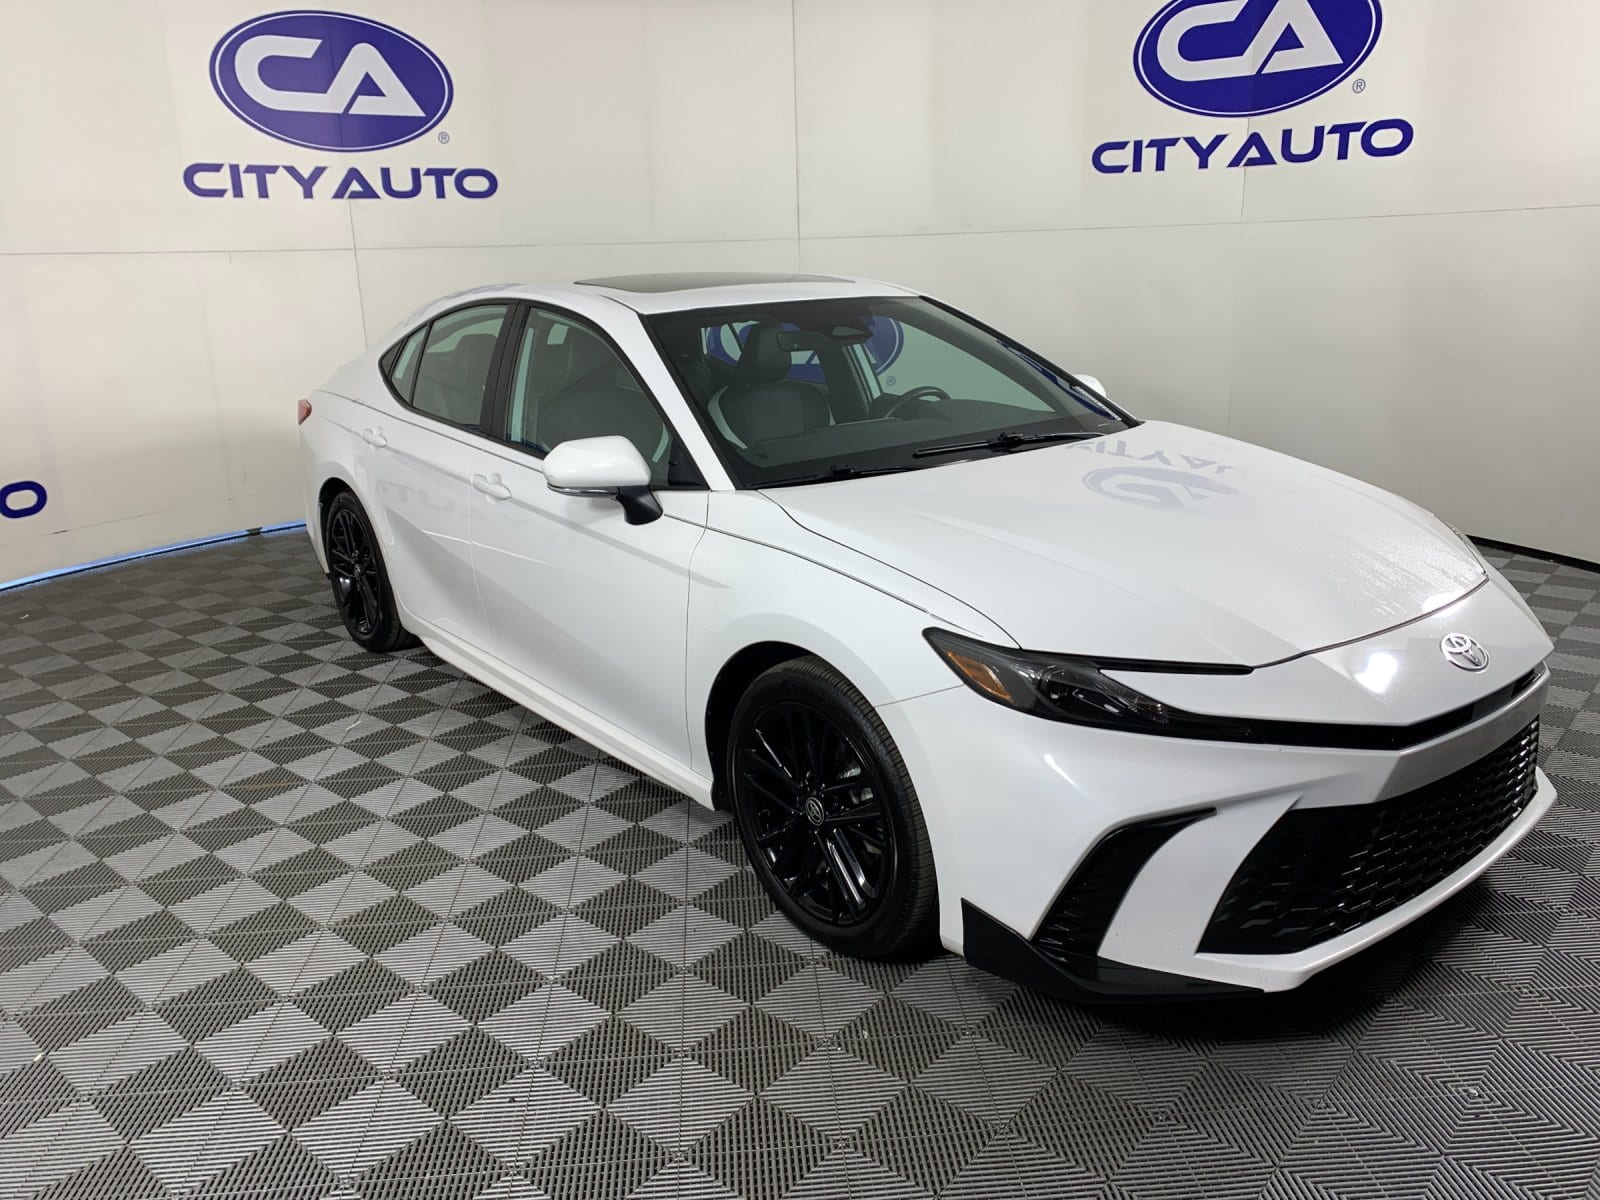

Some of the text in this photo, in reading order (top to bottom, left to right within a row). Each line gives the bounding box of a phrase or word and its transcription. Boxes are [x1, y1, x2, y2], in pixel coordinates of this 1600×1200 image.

[234, 34, 427, 117] CA
[1156, 0, 1345, 83] CA
[182, 162, 499, 199] CITY AUTO
[1091, 118, 1414, 174] CITY AUTO
